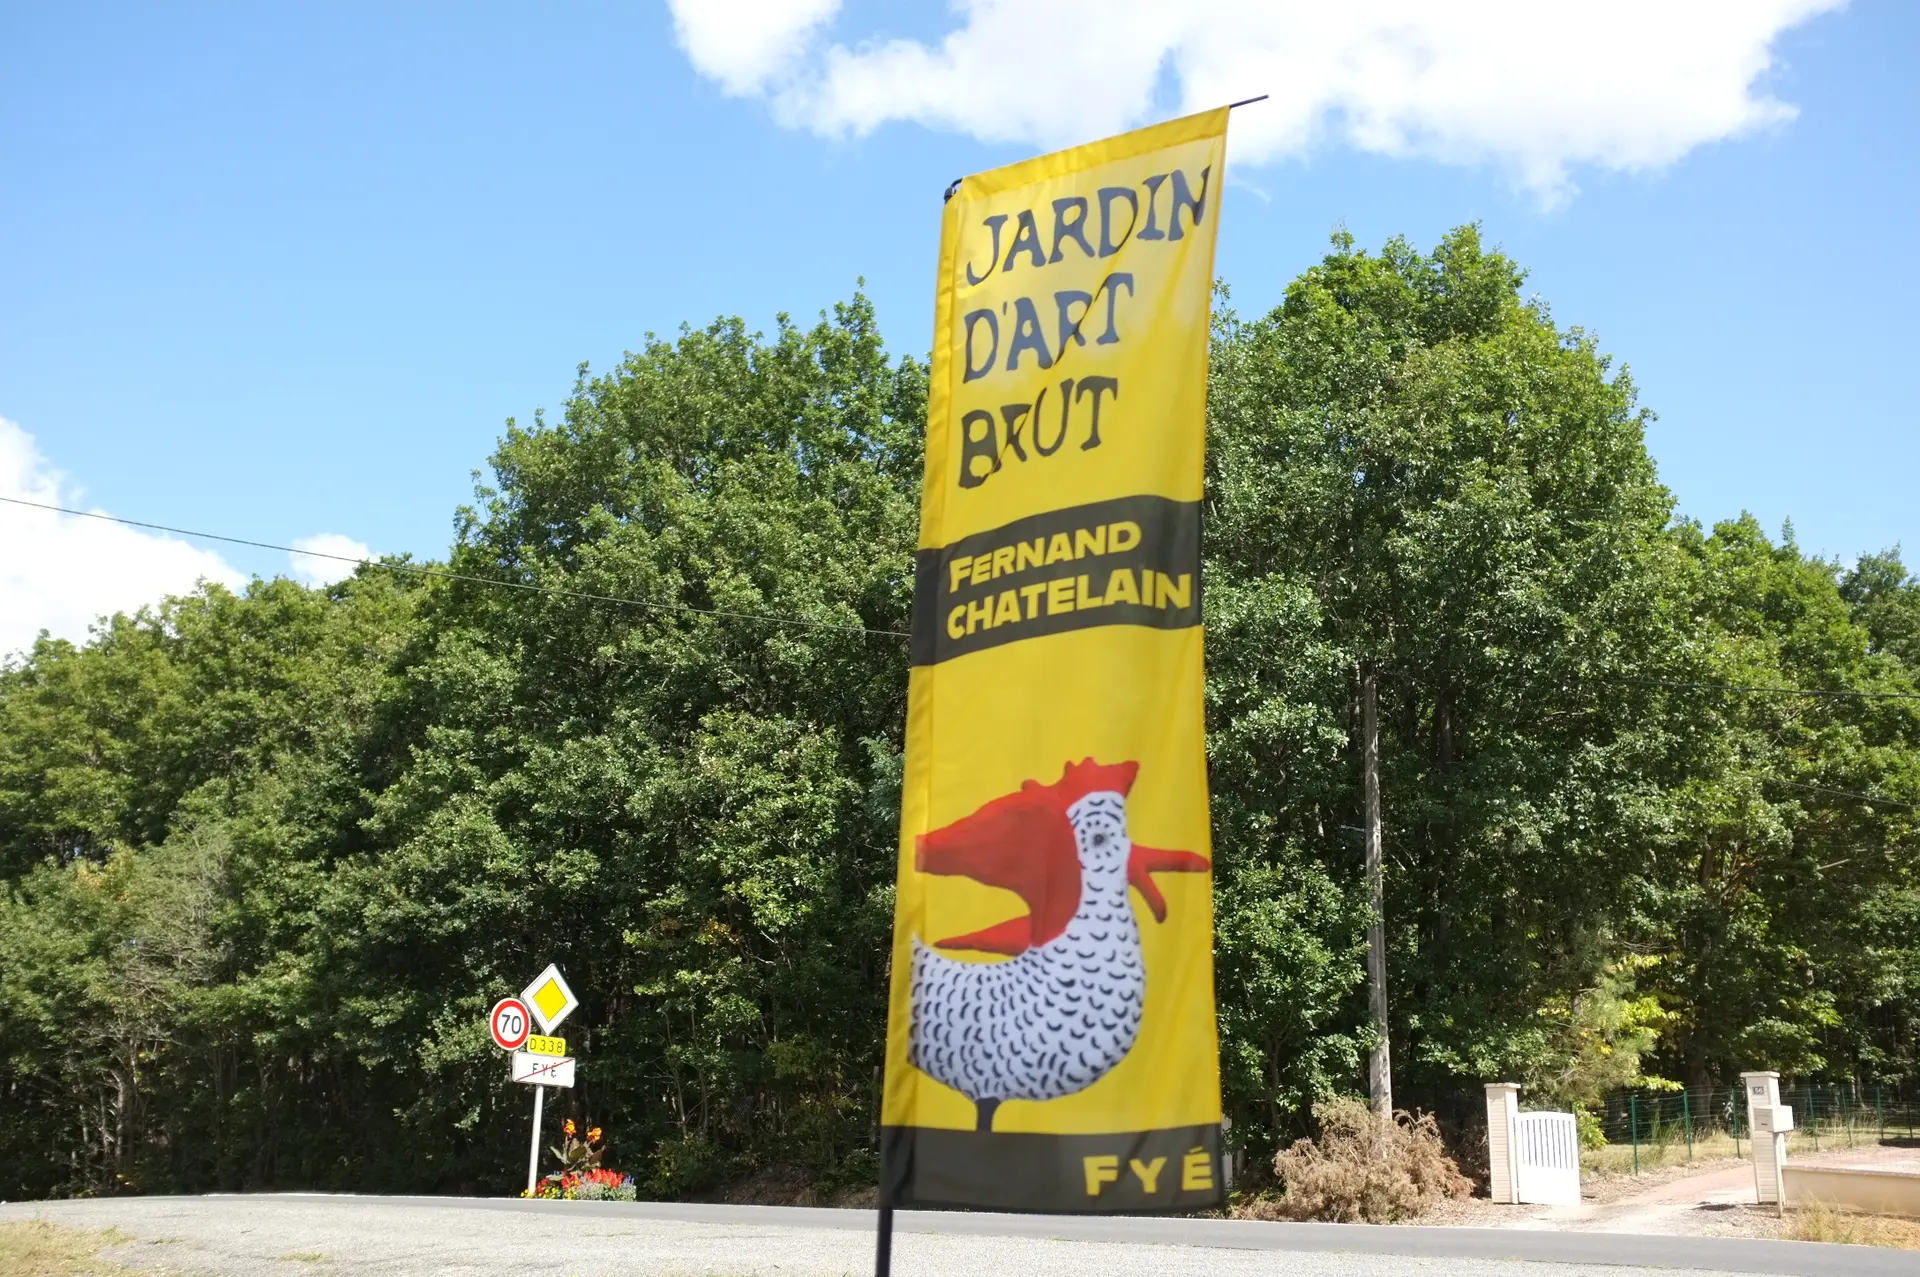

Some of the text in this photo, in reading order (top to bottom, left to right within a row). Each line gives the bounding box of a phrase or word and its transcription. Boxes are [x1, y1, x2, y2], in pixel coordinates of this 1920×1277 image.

[966, 164, 1211, 286] JARDIN
[963, 272, 1134, 384] D'ART
[958, 375, 1118, 489] BRUT
[949, 521, 1142, 593] FERNAND
[947, 568, 1192, 640] CHATELAIN
[502, 1014, 521, 1034] 70
[1083, 1146, 1213, 1196] FYÉ
